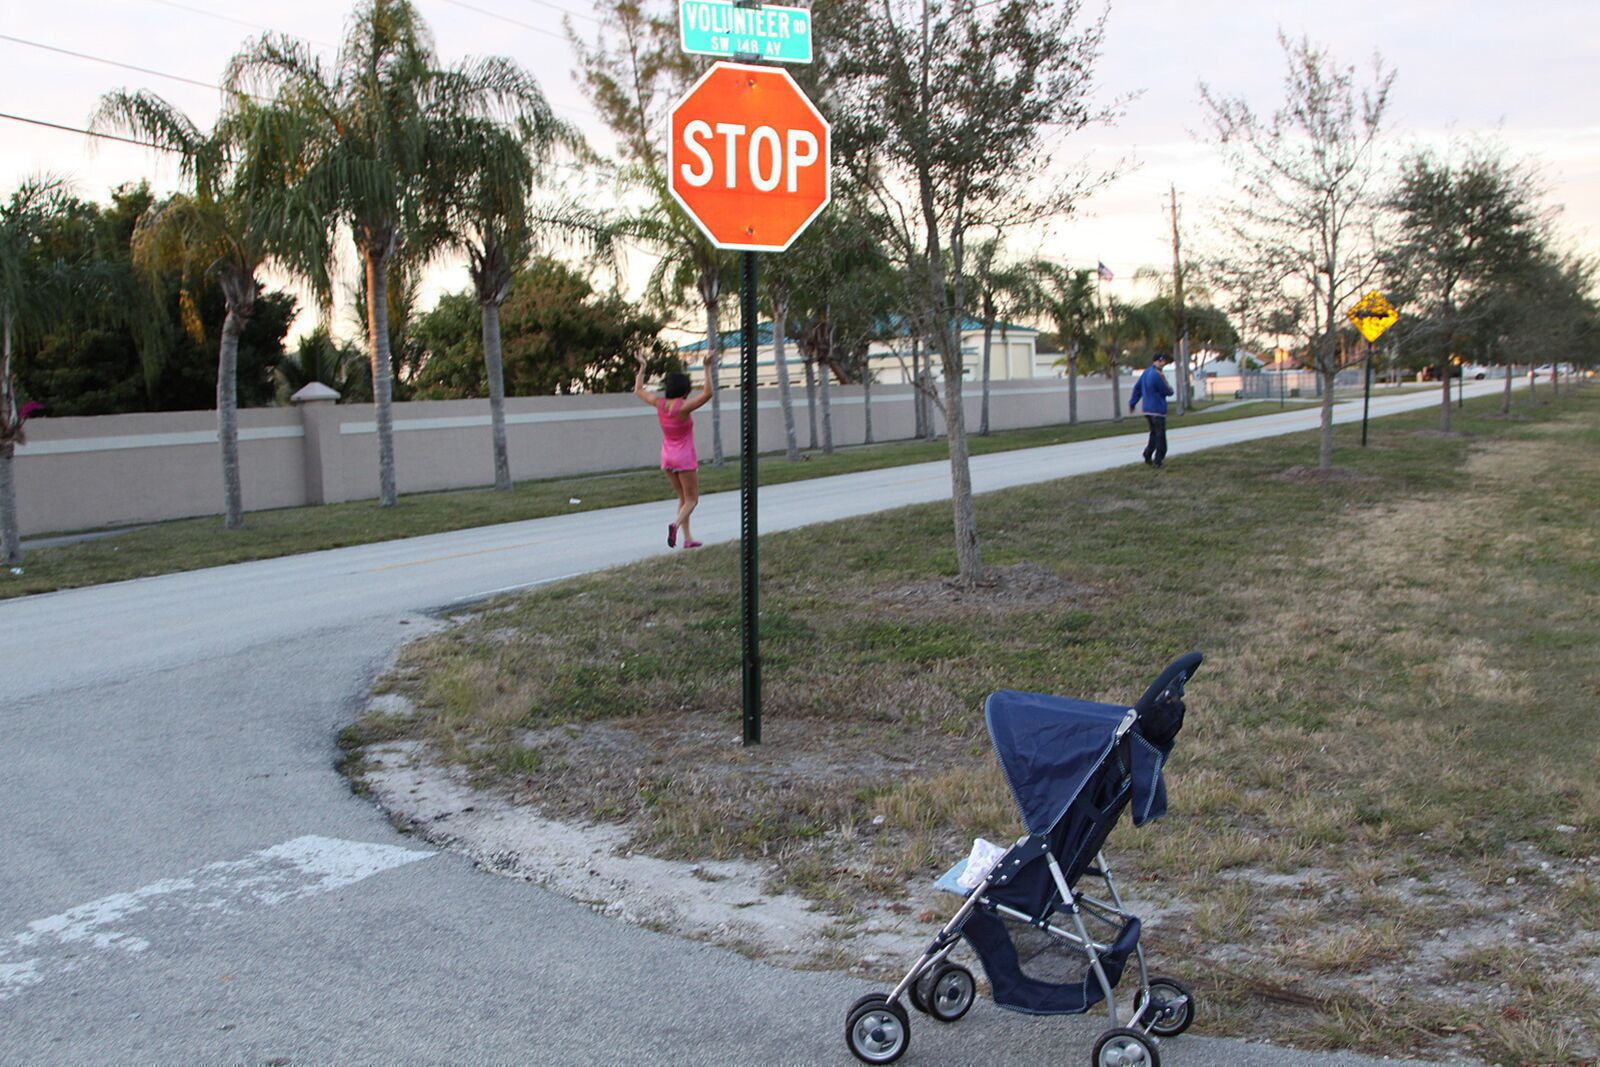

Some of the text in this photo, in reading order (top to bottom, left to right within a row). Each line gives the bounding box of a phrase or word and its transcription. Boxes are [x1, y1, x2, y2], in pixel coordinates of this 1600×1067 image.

[685, 2, 806, 39] VOLUNTEER RD
[711, 36, 782, 55] SW 148 AV
[681, 119, 819, 193] STOP
